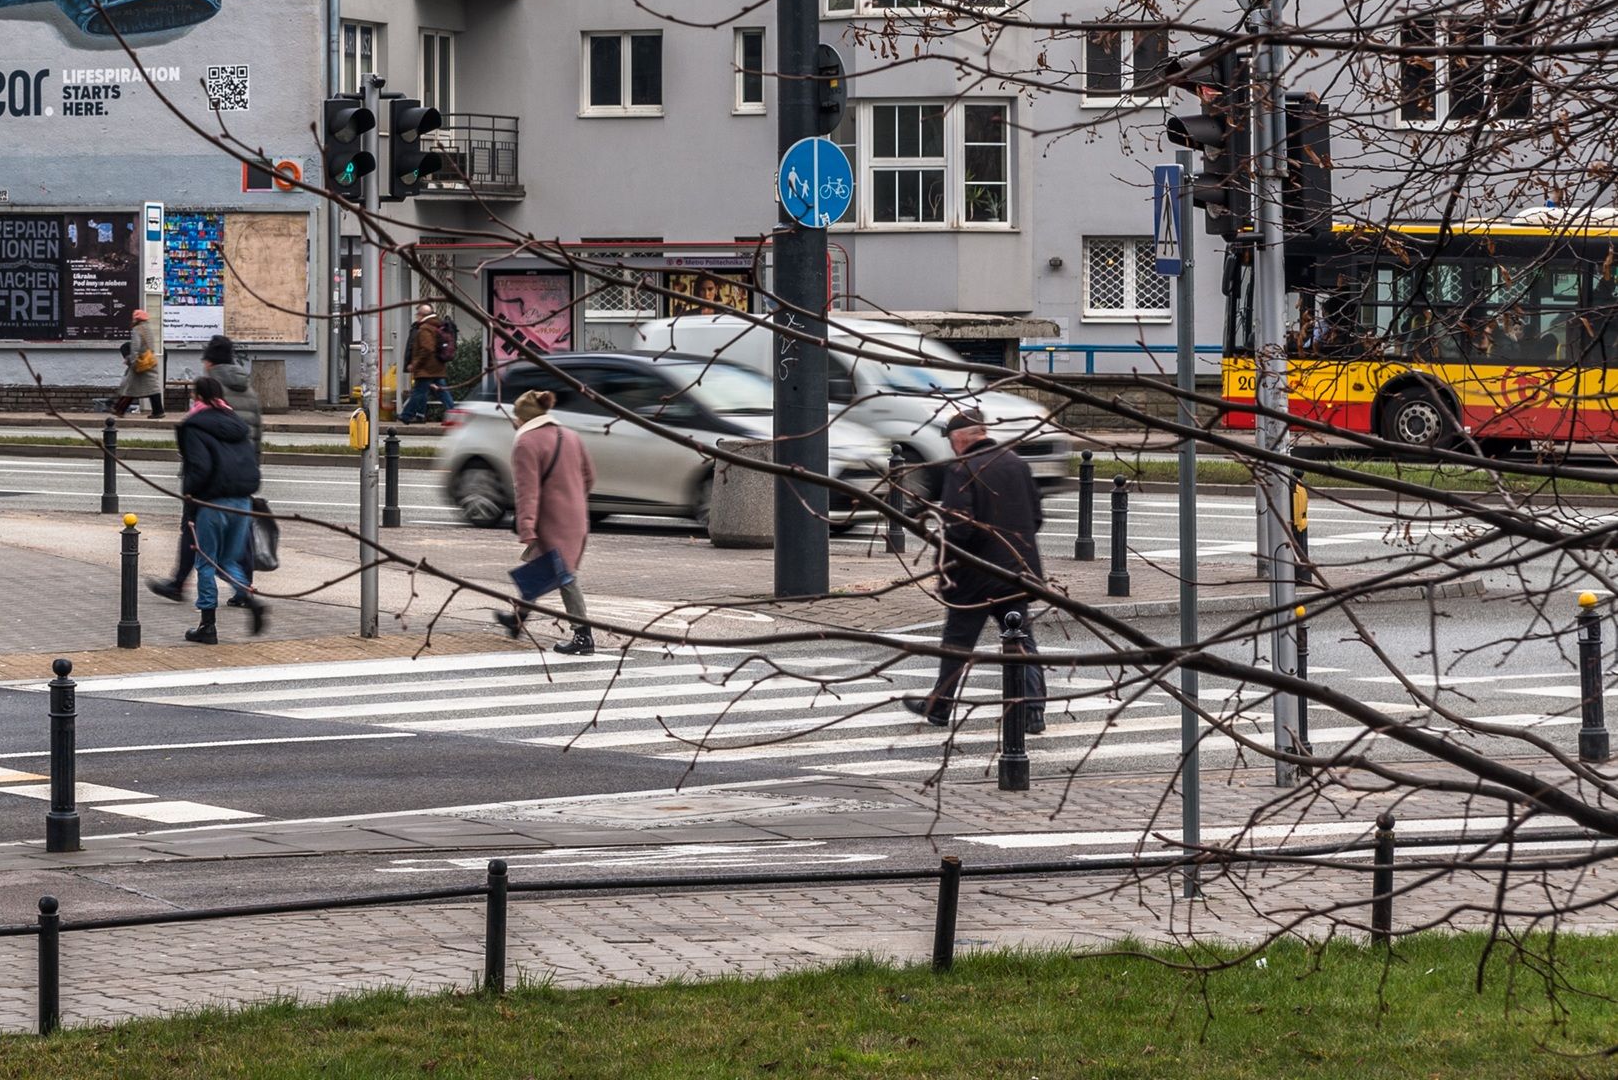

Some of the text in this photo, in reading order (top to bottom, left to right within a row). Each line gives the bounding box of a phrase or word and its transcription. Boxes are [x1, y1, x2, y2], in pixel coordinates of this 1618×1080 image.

[62, 67, 181, 84] LIFESPIRATION
[62, 85, 121, 100] STARTS
[63, 102, 109, 116] HERE.
[706, 258, 743, 266] Politechnika
